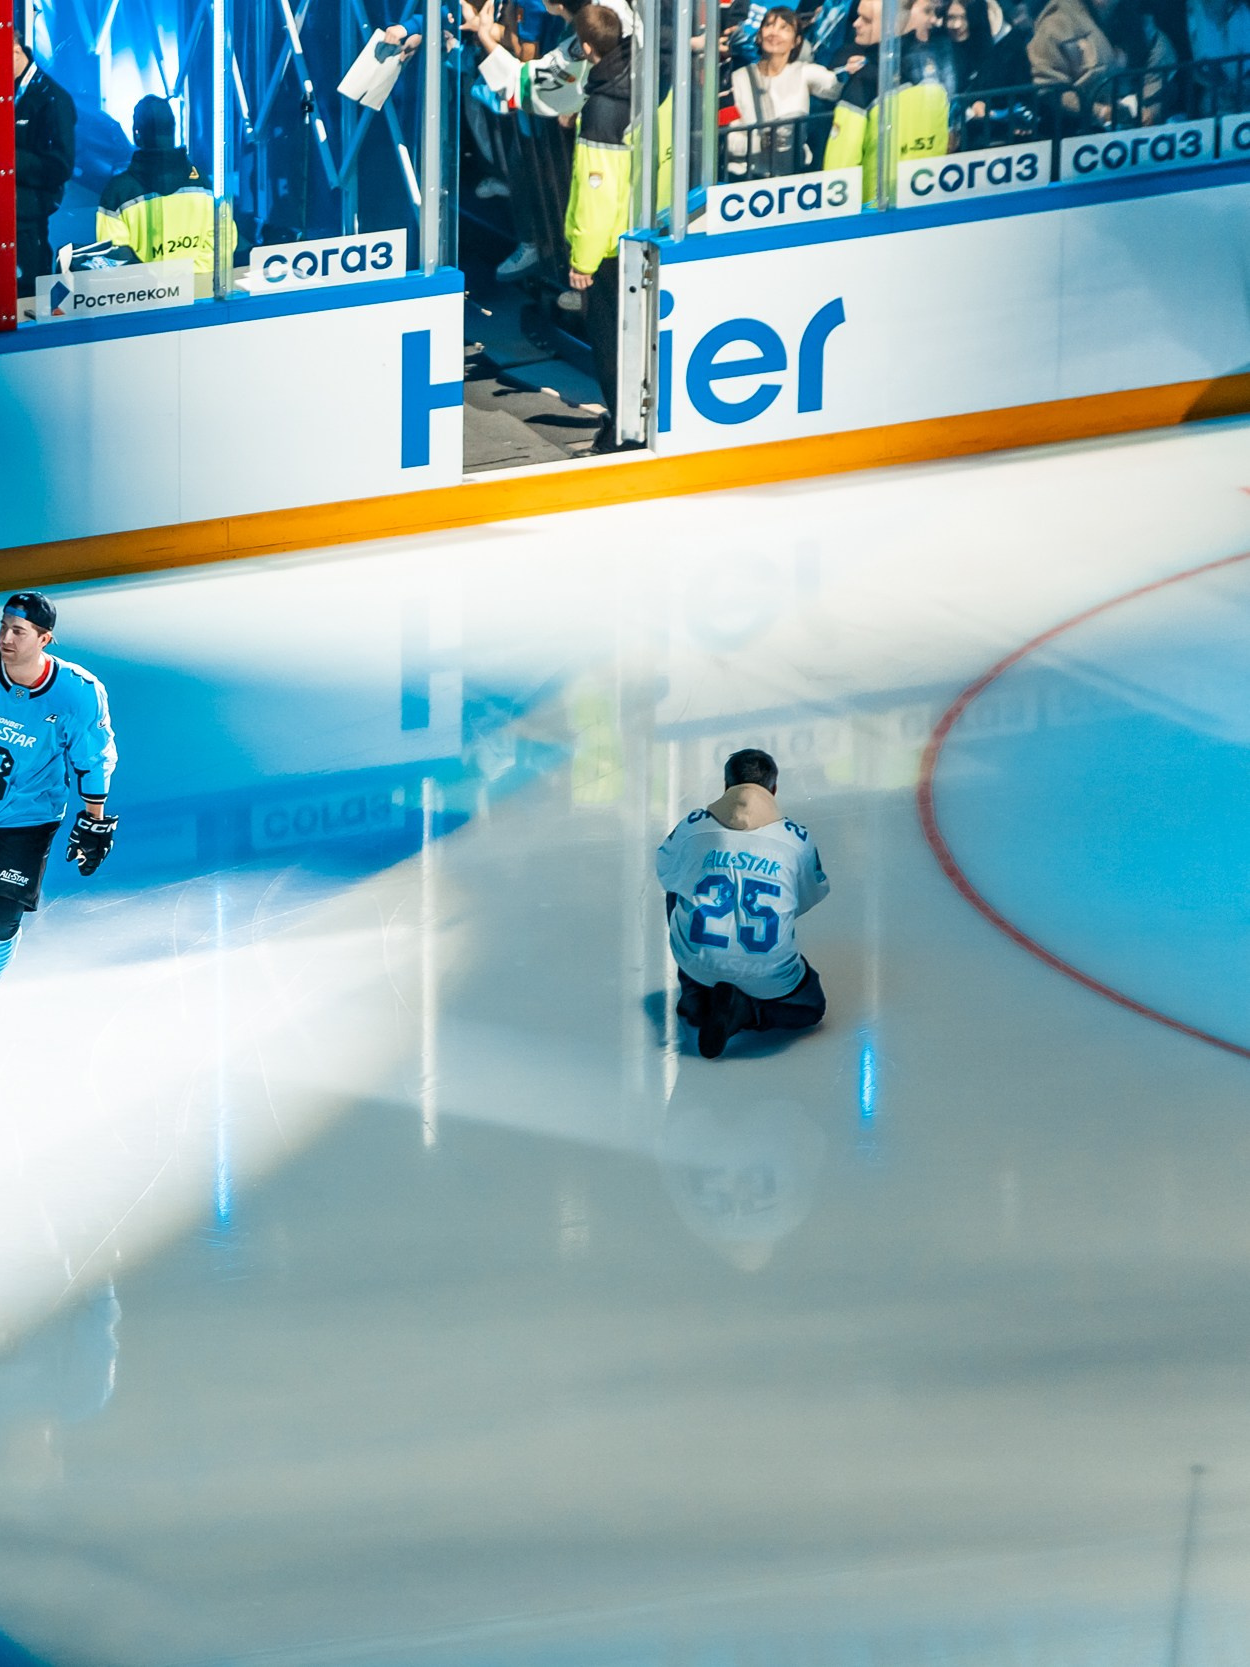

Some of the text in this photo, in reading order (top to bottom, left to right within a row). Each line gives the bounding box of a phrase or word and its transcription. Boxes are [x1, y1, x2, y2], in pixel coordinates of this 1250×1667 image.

[1073, 129, 1203, 174] согаз
[910, 153, 1039, 197] согаз
[720, 179, 849, 222] согаз
[262, 241, 394, 283] согаз
[73, 285, 181, 310] Ростелеком
[688, 873, 782, 955] 25
